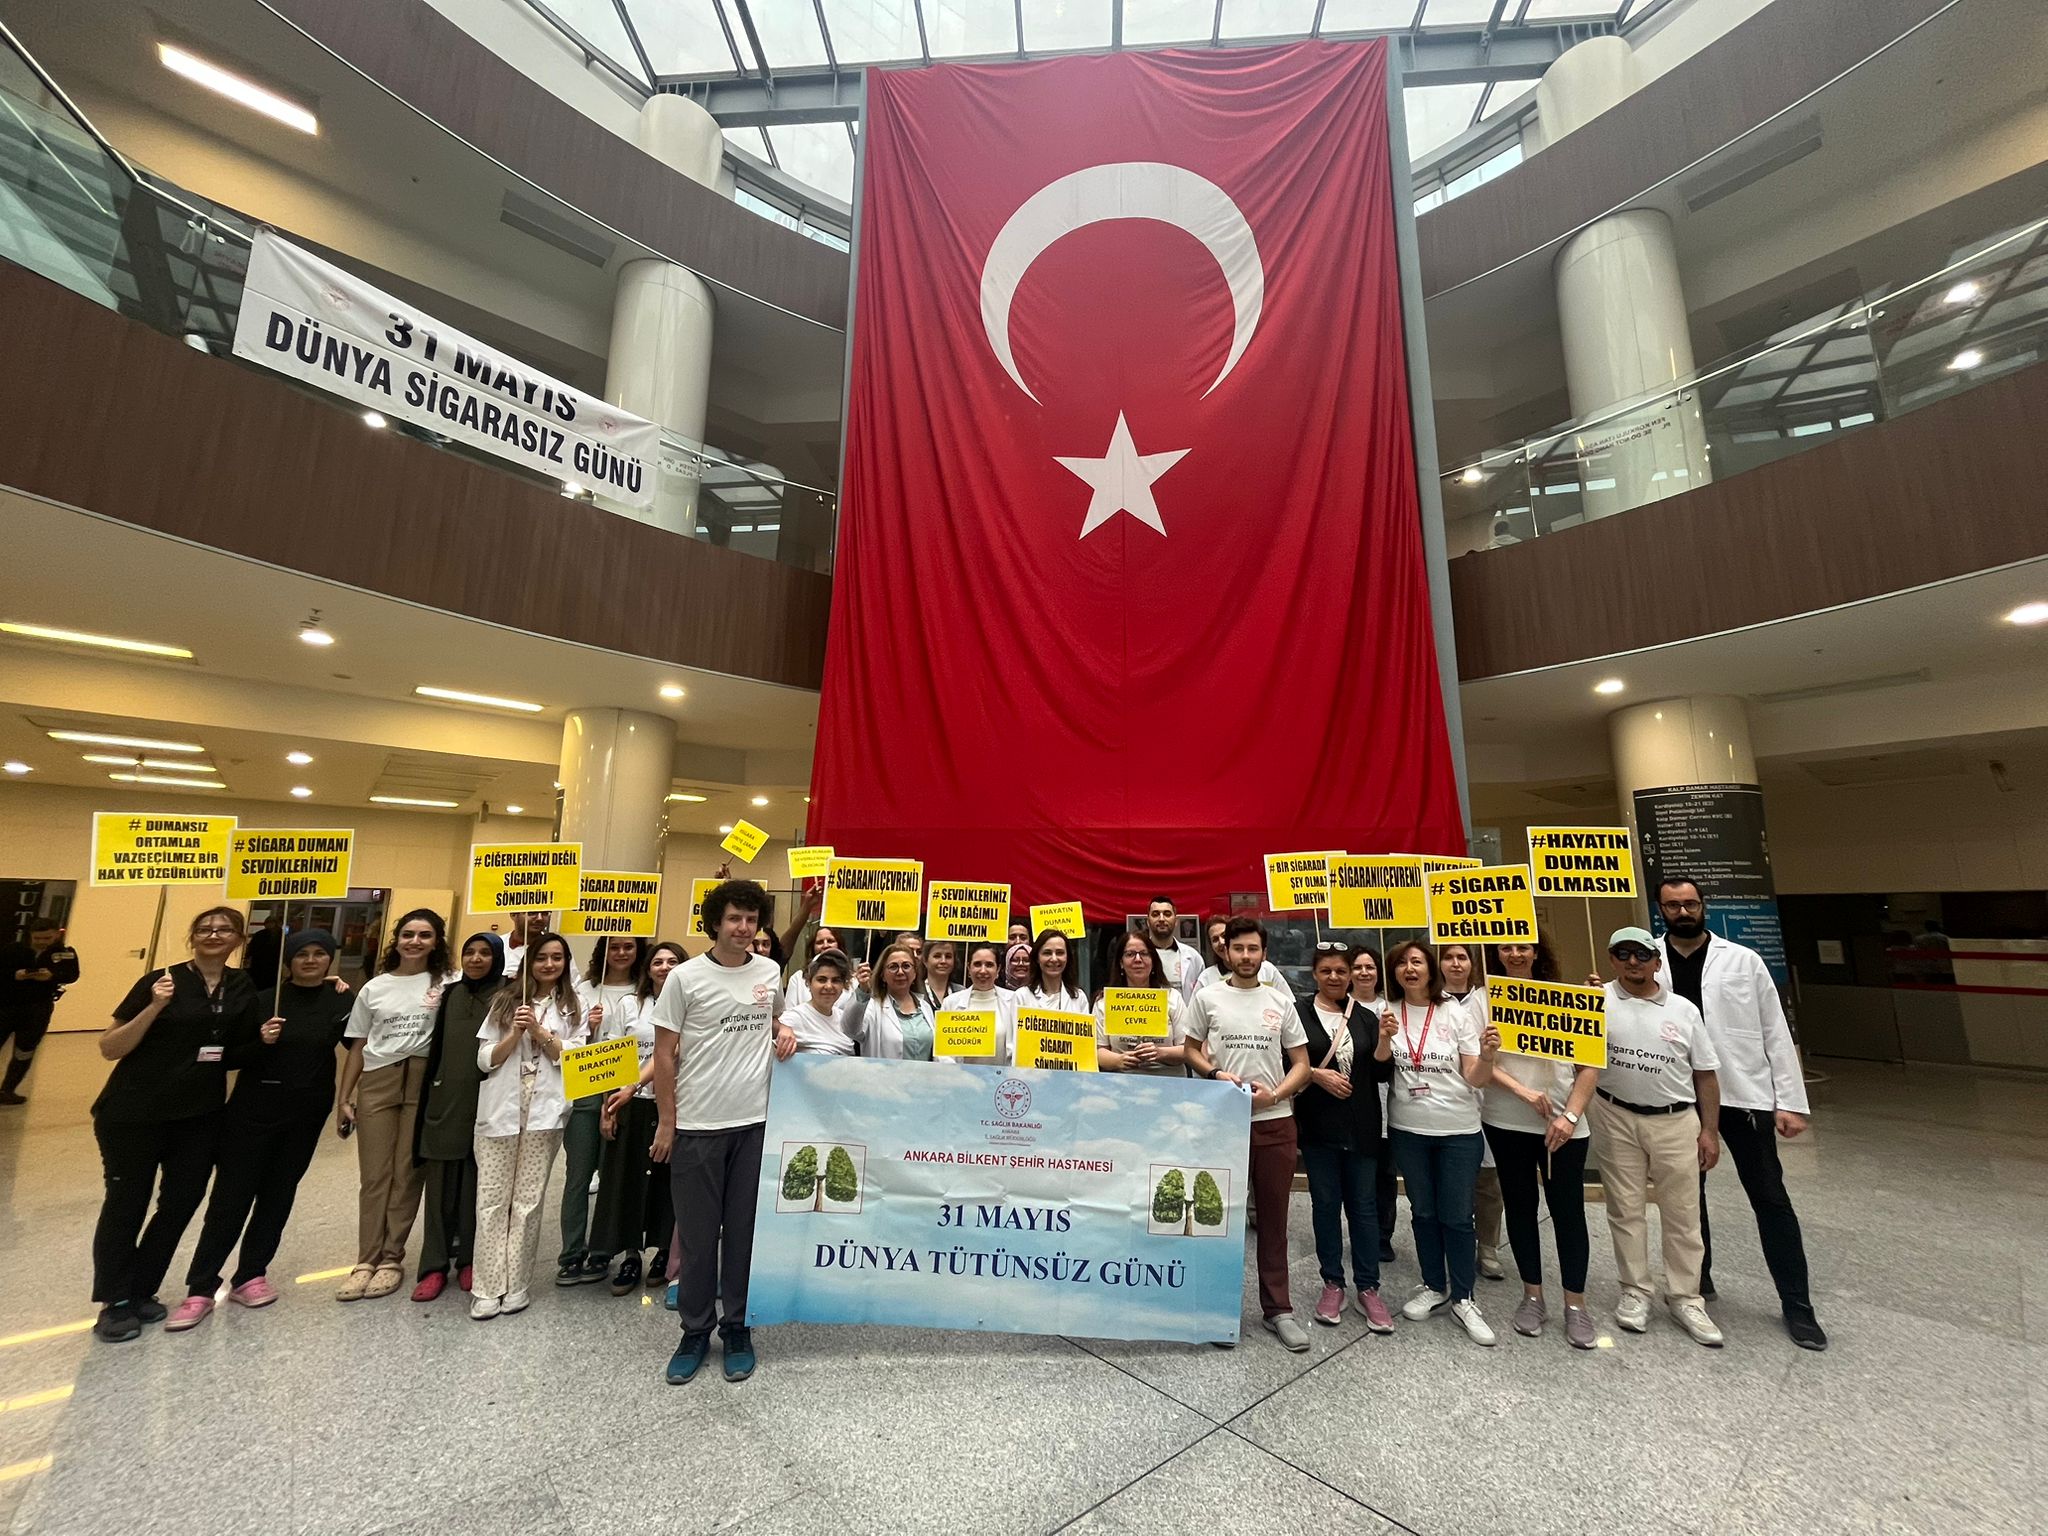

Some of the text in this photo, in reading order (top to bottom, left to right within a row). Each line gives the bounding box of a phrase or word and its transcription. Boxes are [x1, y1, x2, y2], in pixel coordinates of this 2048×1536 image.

[386, 312, 578, 422] 31 MAYIS
[265, 311, 643, 494] DÜNYA SİGARASIZ GÜNÜ
[146, 820, 209, 832] DUMANSIZ
[135, 837, 200, 848] ORTAMLAR
[247, 837, 295, 852] SİGARA
[298, 838, 348, 852] DUMANI
[1531, 833, 1629, 849] #HAYATIN
[114, 850, 219, 865] VAZGEÇİLMEZ BİR
[241, 856, 338, 874] SEVDİKLERİNİZİ
[484, 851, 549, 867] CİĞERLERİNİZİ
[552, 850, 577, 865] DEĞİL
[1545, 855, 1619, 870] DUMAN
[98, 866, 226, 880] HAK VE ÖZGÜRLÜKTÜ
[1276, 860, 1289, 873] BİR
[504, 870, 547, 886] SİGARAYI
[1290, 876, 1304, 890] ŞEY
[1449, 874, 1526, 894] SİGARA
[1538, 876, 1631, 893] OLMASIN
[258, 879, 317, 895] ÖLDÜRÜR
[617, 880, 657, 894] DUMANI
[941, 887, 1007, 903] SEVDİKLERİNİZ
[496, 889, 548, 906] SÖNDÜRÜN
[573, 897, 648, 913] EVDİKLERİNİZİ
[1294, 890, 1326, 904] DEMEYİN
[856, 899, 885, 921] YAKMA
[939, 904, 998, 920] İÇİN BAĞIMLI
[1363, 898, 1394, 920] YAKMA
[1452, 898, 1504, 915] DOST
[584, 916, 631, 932] ÖLDÜRÜR
[948, 923, 987, 937] OLMAYIN
[1044, 918, 1071, 926] DUMAN
[1437, 917, 1530, 937] DEĞİLDİR
[1116, 992, 1157, 1000] #SİGARASIZ
[1507, 983, 1605, 1013] SİGARASIZ
[1138, 1004, 1161, 1012] GÜZEL
[951, 1014, 980, 1022] #SİGARA
[1024, 1015, 1074, 1035] CİĞERLERİNİZİ
[1075, 1022, 1093, 1037] DEĞİL
[1124, 1017, 1148, 1025] ÇEVRE
[750, 1023, 764, 1031] EVET
[942, 1025, 988, 1034] GELECEĞİNİZİ
[595, 1040, 634, 1056] SİGARAYI
[947, 1037, 982, 1046] ÖLDÜRÜR
[1040, 1036, 1072, 1055] SİGARAYI
[1517, 1033, 1575, 1058] ÇEVRE
[1636, 1048, 1676, 1064] Çevreye
[1610, 1056, 1662, 1074] Zarar Verir
[590, 1071, 615, 1083] DEYİN
[904, 1150, 1113, 1173] ANKARA BİLKENT ŞEHİR HASTANESİ
[937, 1204, 1071, 1232] 31 MAYIS
[814, 1239, 1187, 1289] DÜNYA TÜTÜNSÜZ GÜNÜ
